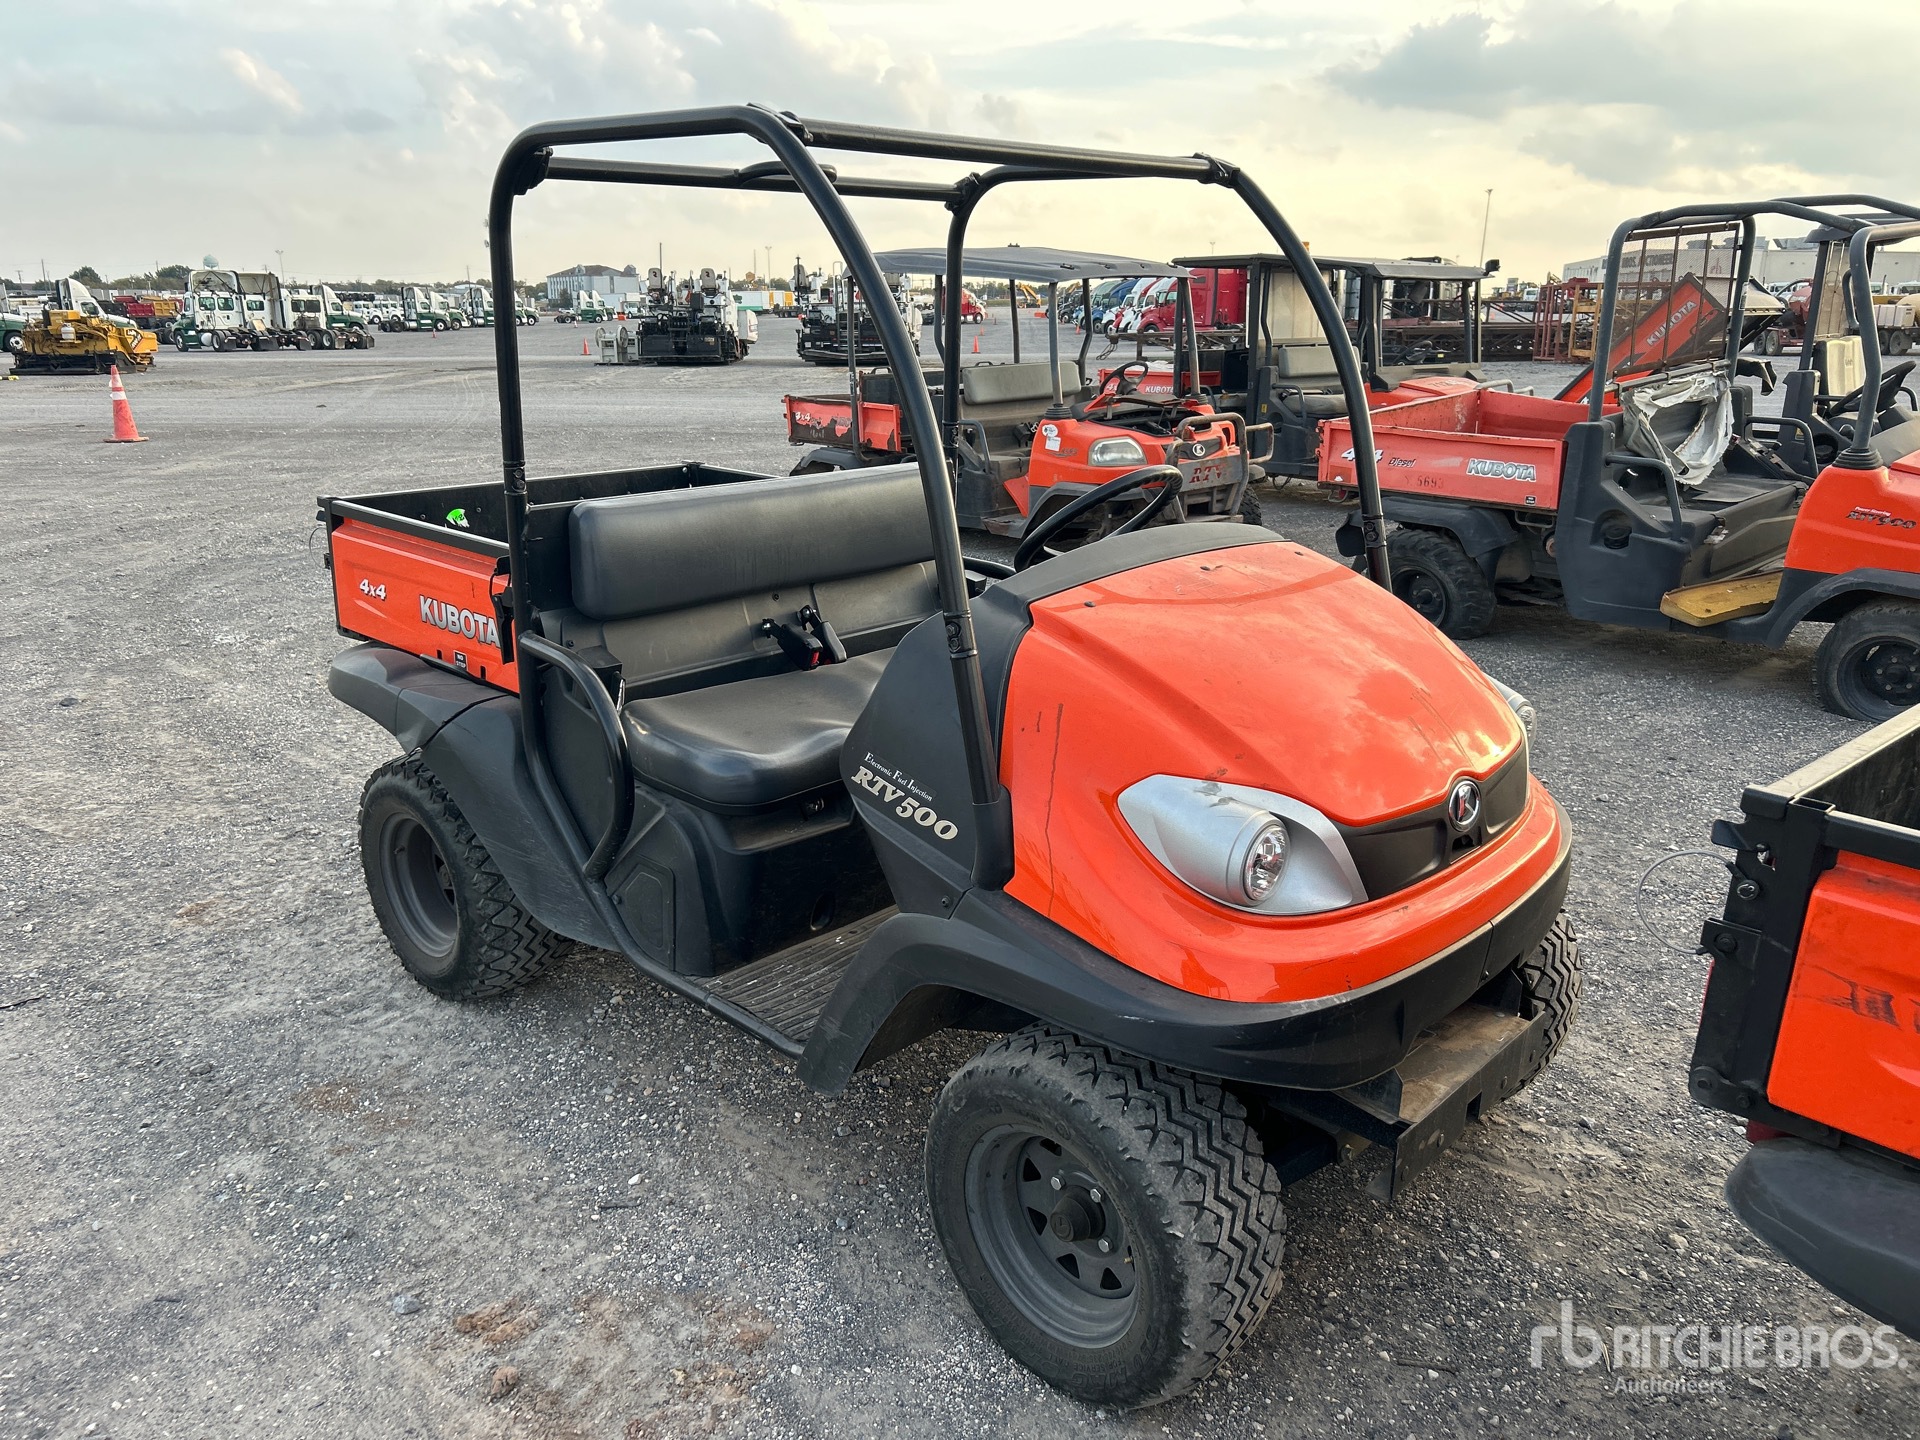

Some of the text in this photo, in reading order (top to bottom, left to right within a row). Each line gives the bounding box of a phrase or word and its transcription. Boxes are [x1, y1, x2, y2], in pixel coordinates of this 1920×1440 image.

[1341, 448, 1416, 469] 44 Diesel
[1467, 459, 1536, 482] KUBOTA
[360, 579, 387, 601] 4x4
[419, 594, 501, 649] KUBOTA
[864, 752, 933, 802] Electronic Fuel Injection
